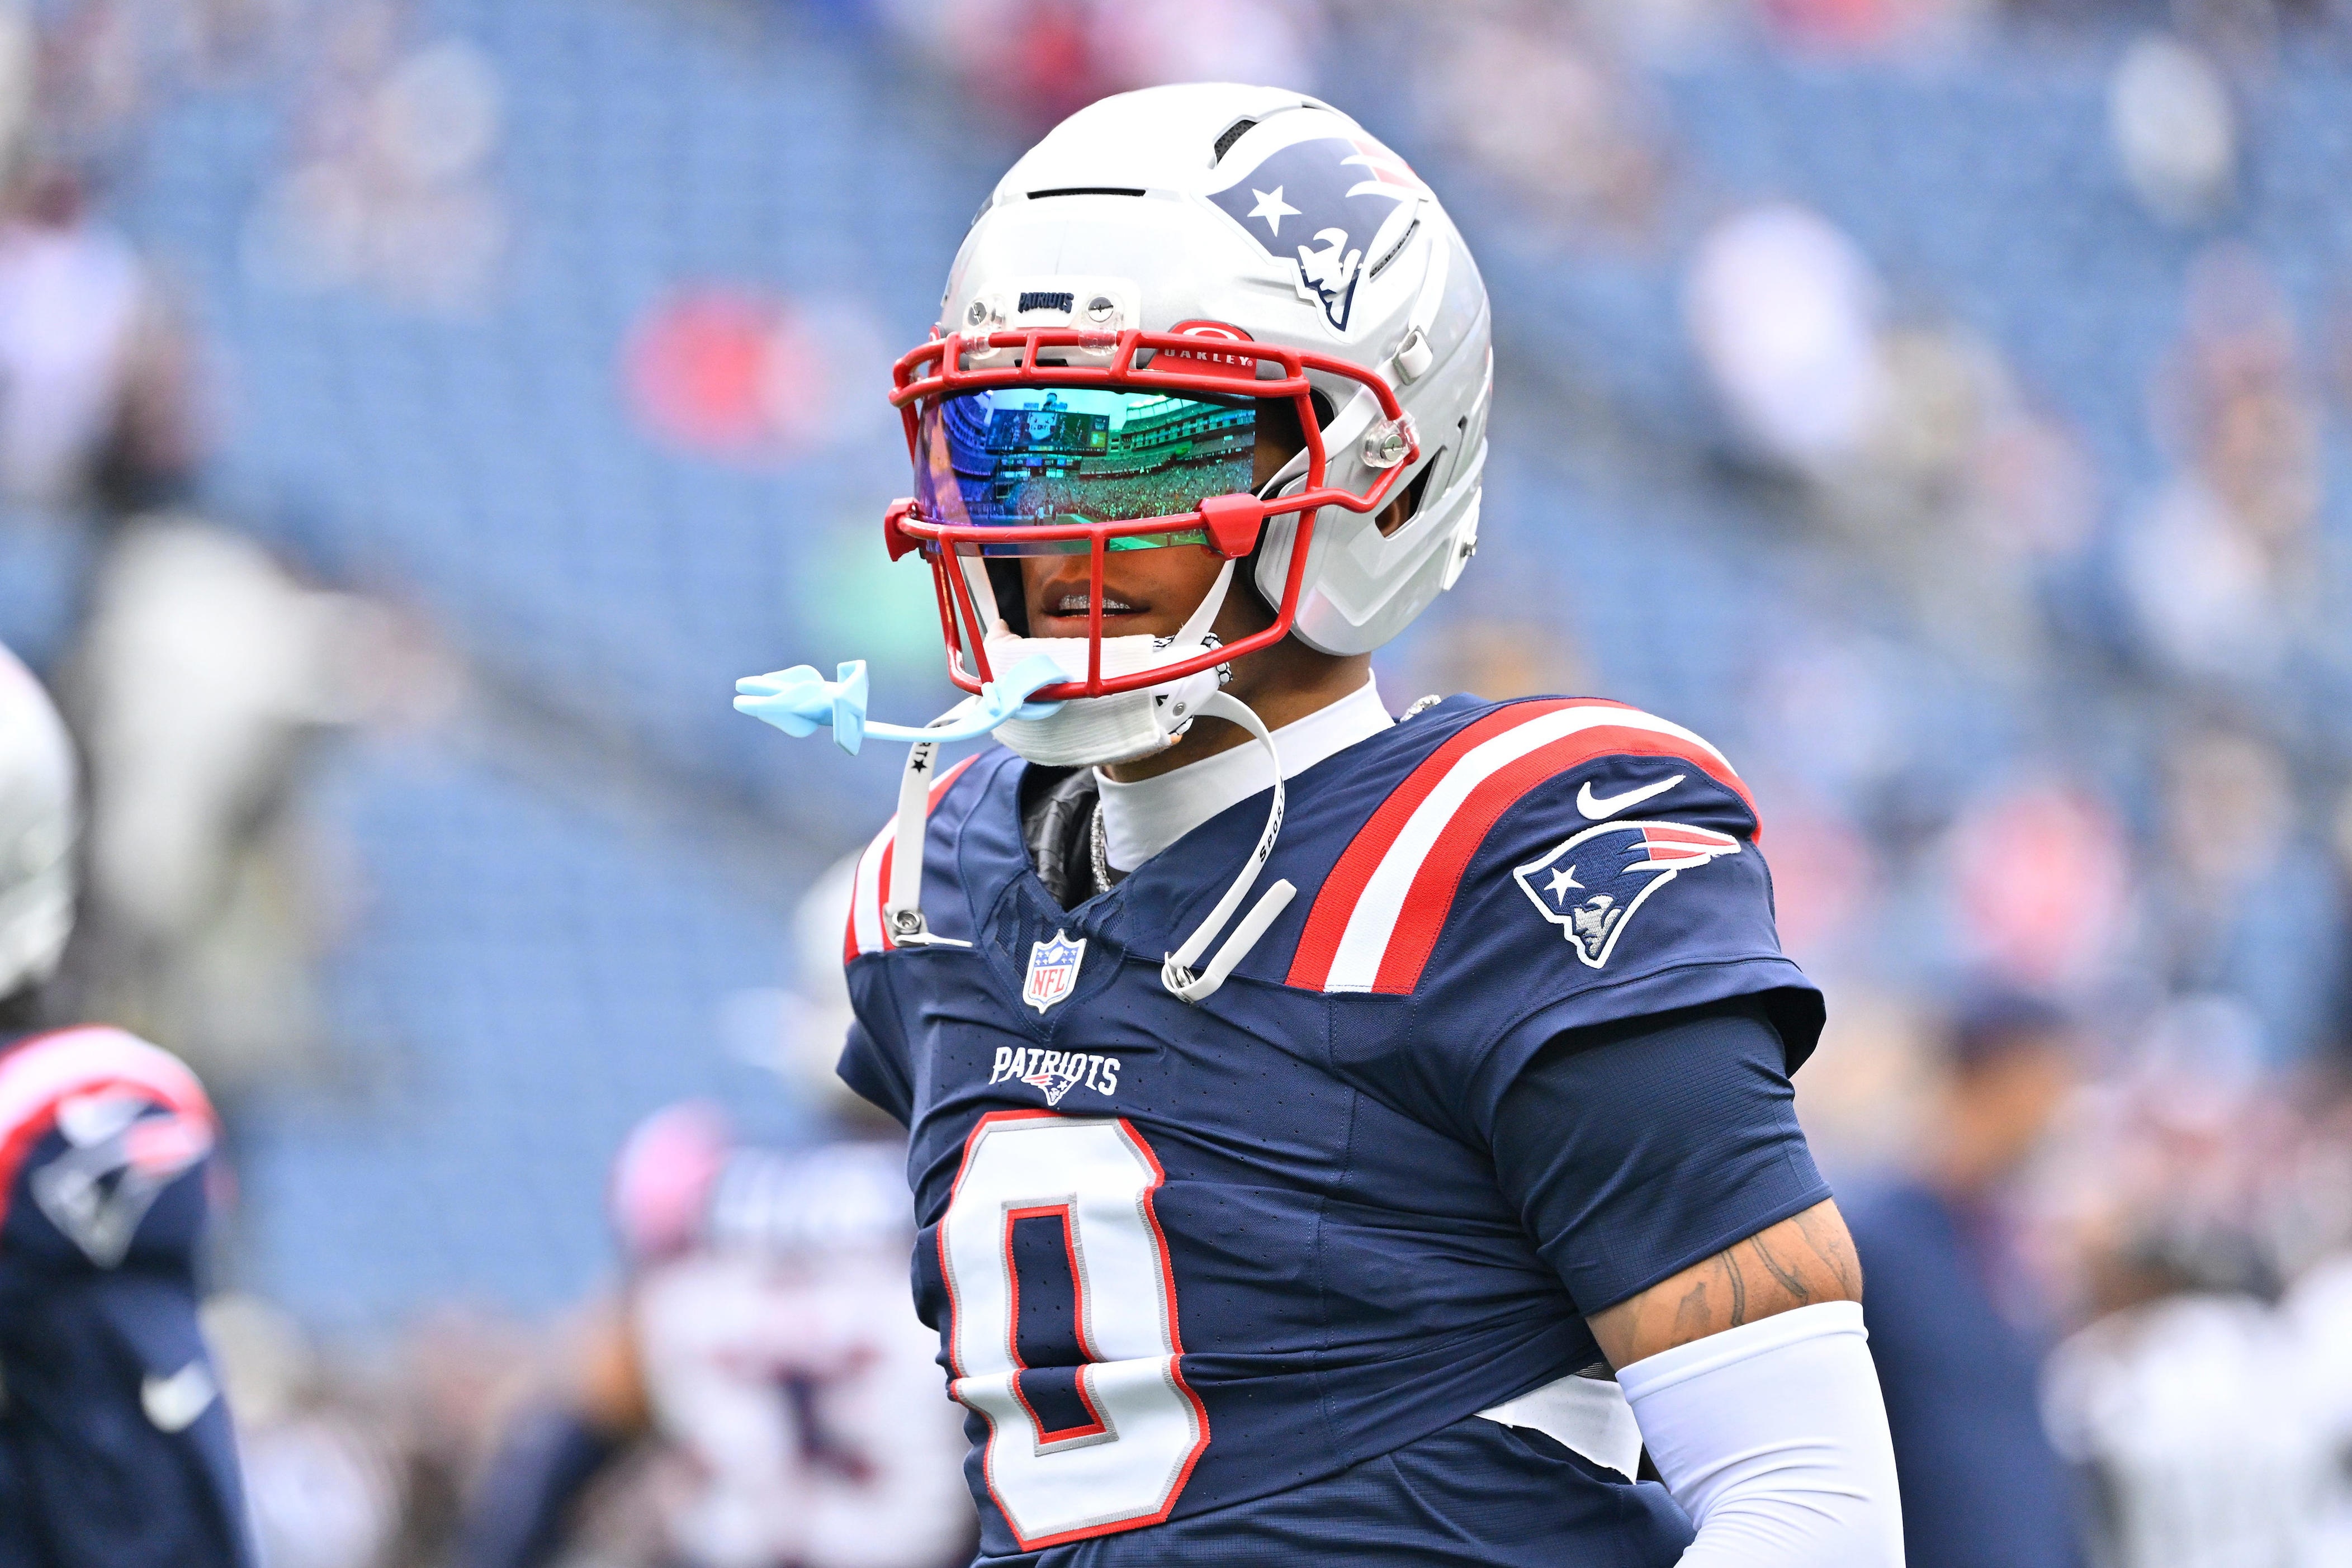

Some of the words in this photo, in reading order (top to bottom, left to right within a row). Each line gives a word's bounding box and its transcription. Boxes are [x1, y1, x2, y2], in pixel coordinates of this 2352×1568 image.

[1018, 292, 1074, 314] PATRIOTS
[1032, 968, 1064, 997] NFL
[988, 1046, 1121, 1096] PATRIOTS
[937, 1109, 1211, 1552] 0
